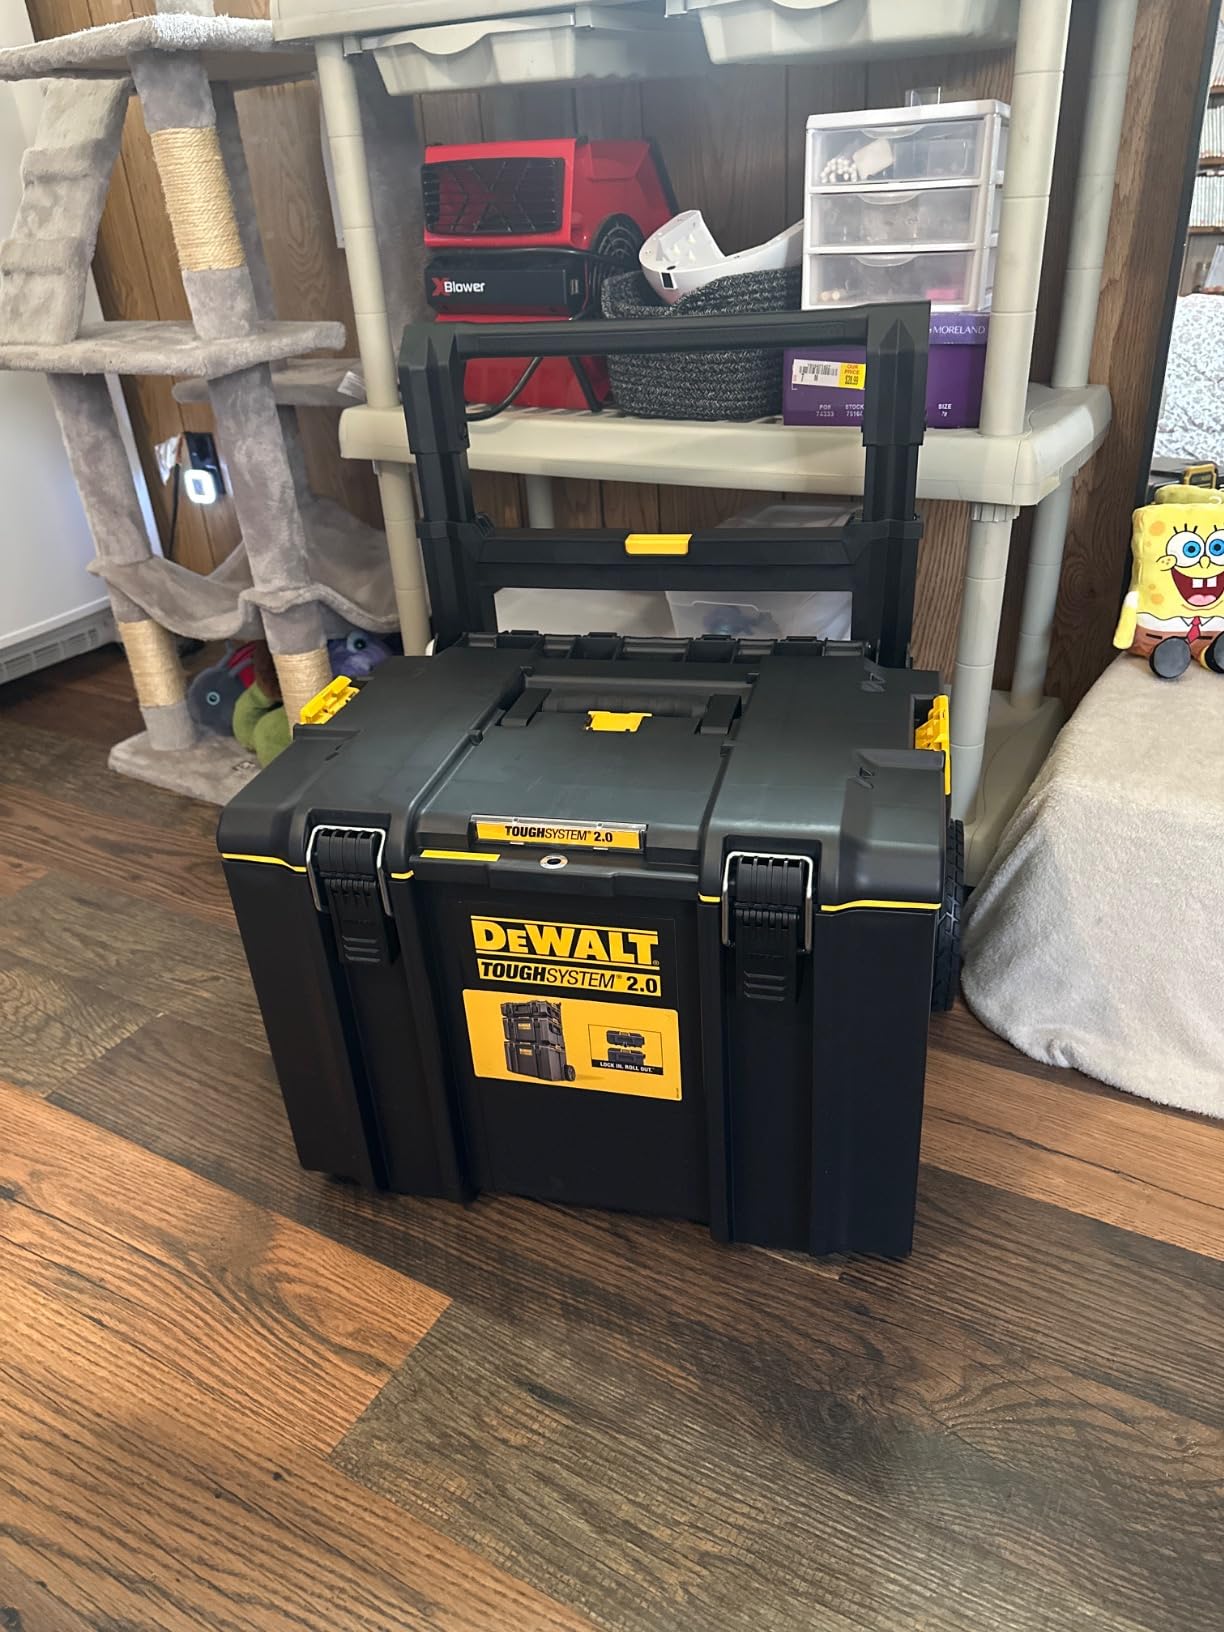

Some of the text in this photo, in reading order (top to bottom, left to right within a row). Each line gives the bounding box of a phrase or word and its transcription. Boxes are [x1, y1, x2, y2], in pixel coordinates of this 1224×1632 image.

[932, 325, 986, 334] MORELAND
[594, 831, 613, 843] 2.0
[626, 976, 658, 994] 2.0
[599, 1061, 614, 1069] LOCK
